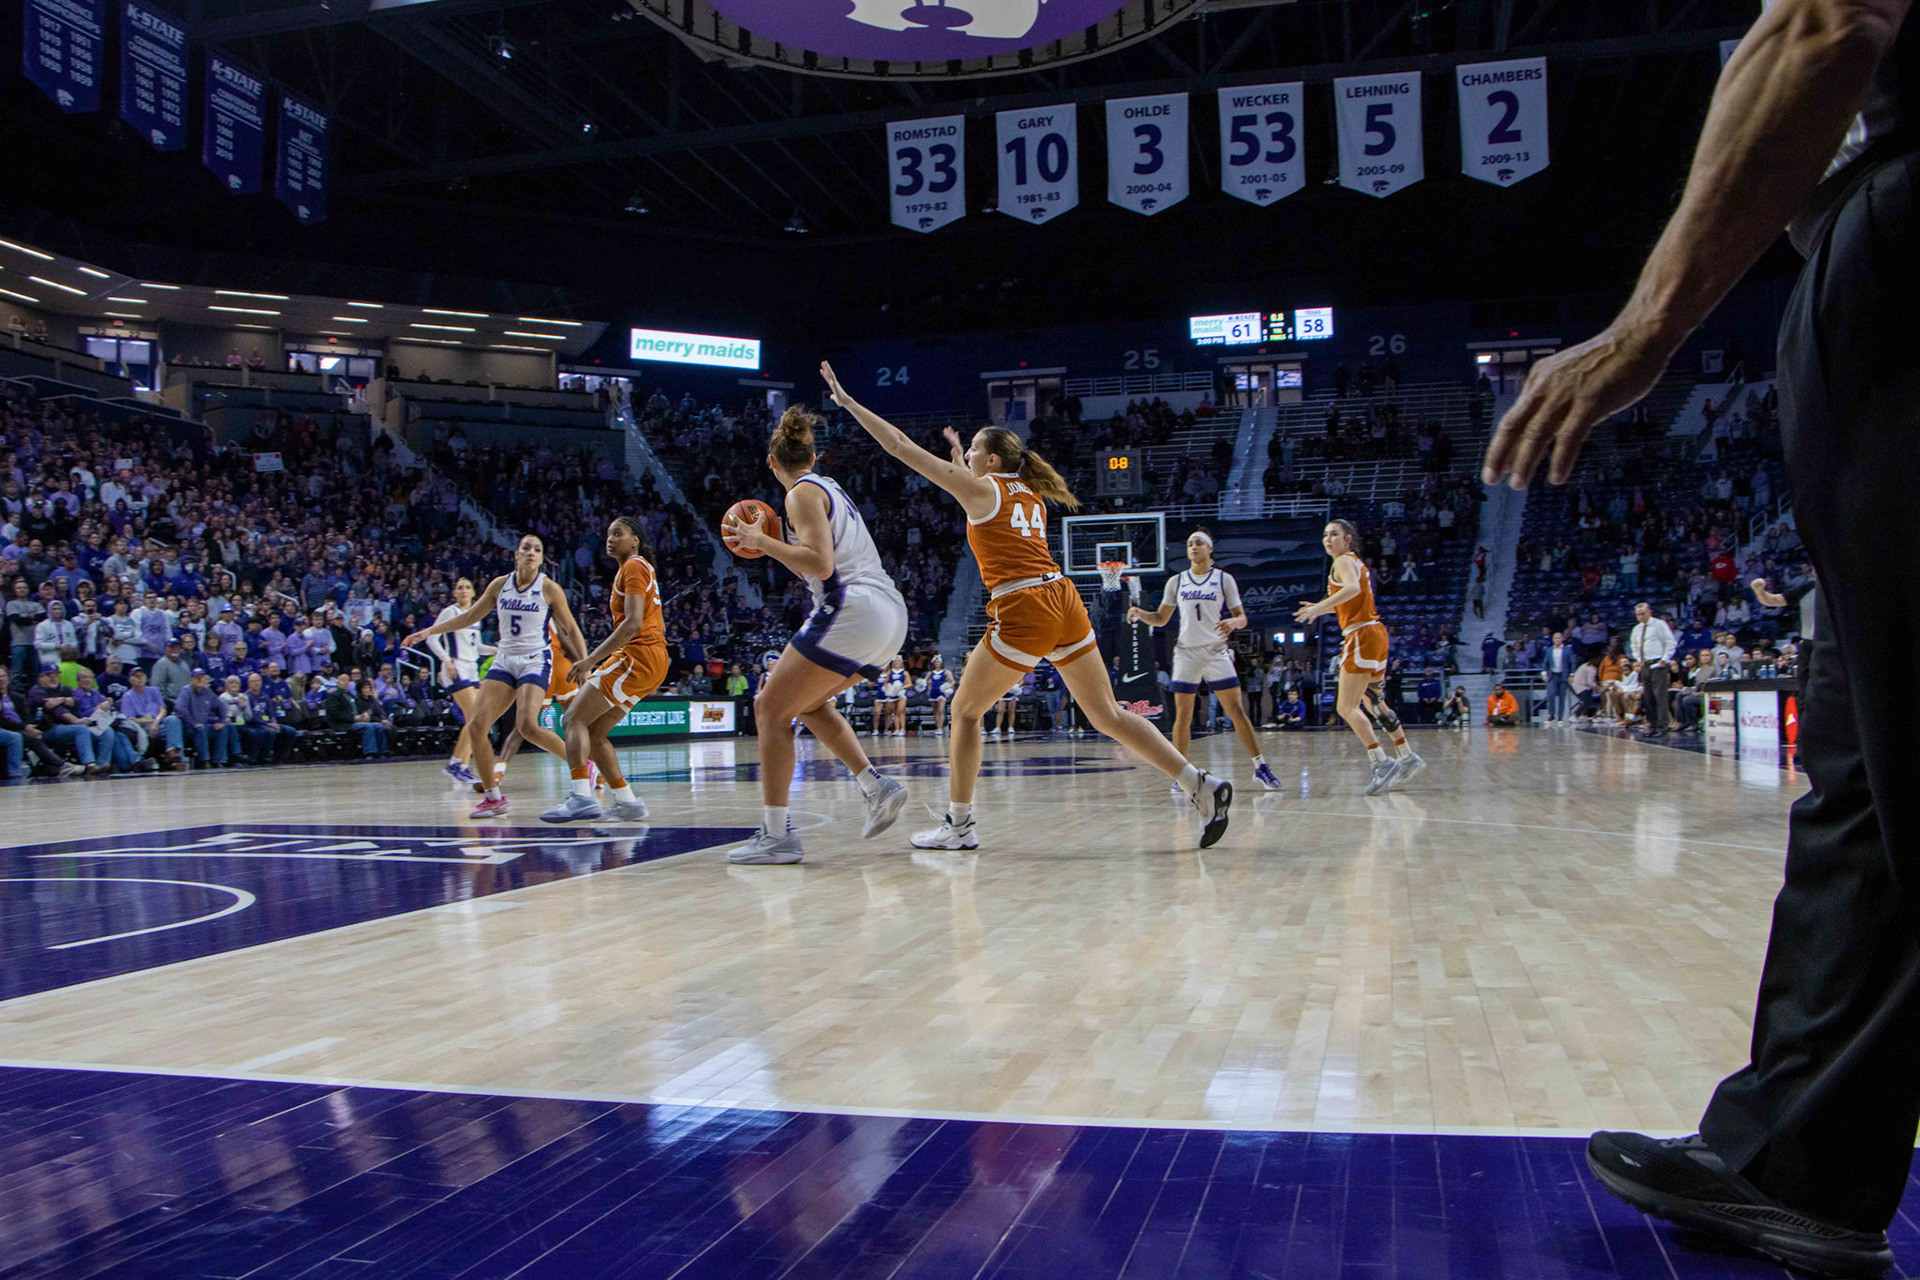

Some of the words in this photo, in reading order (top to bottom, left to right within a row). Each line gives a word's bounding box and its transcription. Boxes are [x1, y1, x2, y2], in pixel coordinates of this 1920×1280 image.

[127, 3, 185, 44] K-STATE
[211, 59, 263, 96] K-STATE
[1461, 68, 1543, 87] CHAMBERS
[1346, 83, 1410, 99] LEHNING
[1231, 93, 1290, 109] WECKER
[283, 96, 328, 130] K-STATE
[1123, 105, 1171, 119] OHLDE
[1486, 89, 1522, 145] 2
[1017, 115, 1055, 131] GARY
[1363, 102, 1397, 157] 5
[893, 125, 957, 142] ROMSTAD
[1229, 111, 1297, 166] 53
[1132, 123, 1165, 175] 3
[1005, 132, 1069, 186] 10
[1480, 152, 1530, 165] 2009-13
[895, 143, 958, 196] 33
[1357, 164, 1405, 176] 2005-09
[1240, 173, 1287, 185] 2001-05
[1126, 182, 1172, 195] 2000-04
[1016, 191, 1061, 205] 1981-83
[905, 201, 948, 214] 1979-82
[1231, 323, 1251, 338] 61
[1303, 318, 1325, 333] 58
[635, 337, 694, 357] merry
[697, 343, 755, 360] maids
[1369, 333, 1407, 355] 26
[1124, 349, 1160, 370] 25
[876, 366, 910, 387] 24
[1010, 502, 1047, 538] 44
[1180, 589, 1218, 602] Wildcats
[1243, 583, 1306, 597] AVAN
[500, 597, 540, 612] Wildcats
[1194, 603, 1202, 621] 1
[510, 615, 523, 637] 5
[668, 710, 686, 725] LINE
